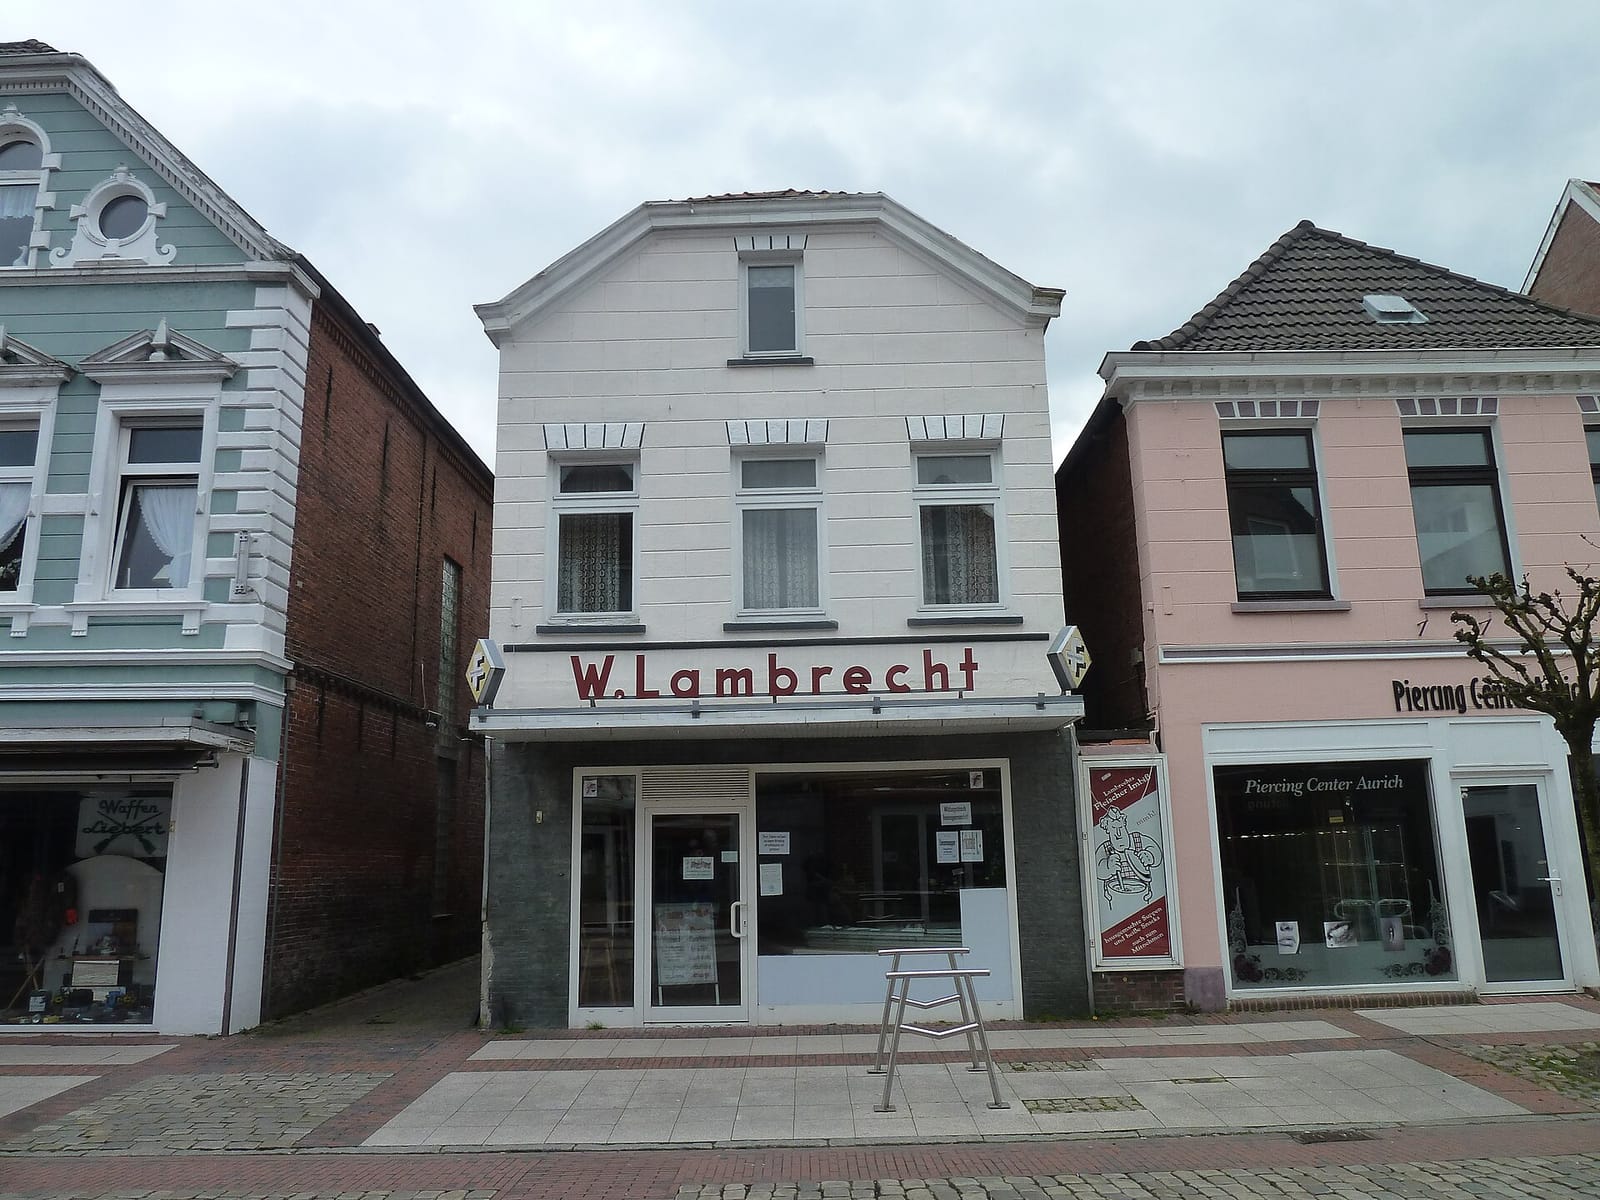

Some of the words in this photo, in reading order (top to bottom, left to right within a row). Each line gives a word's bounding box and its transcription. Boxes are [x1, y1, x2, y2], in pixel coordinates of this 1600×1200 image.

[1392, 680, 1466, 713] Piercing
[1245, 779, 1304, 796] Piercing
[1307, 777, 1353, 792] Center
[1356, 775, 1404, 790] Aurich
[99, 800, 159, 819] Waffen
[1094, 789, 1128, 811] Fleischer
[82, 820, 166, 835] Liebert
